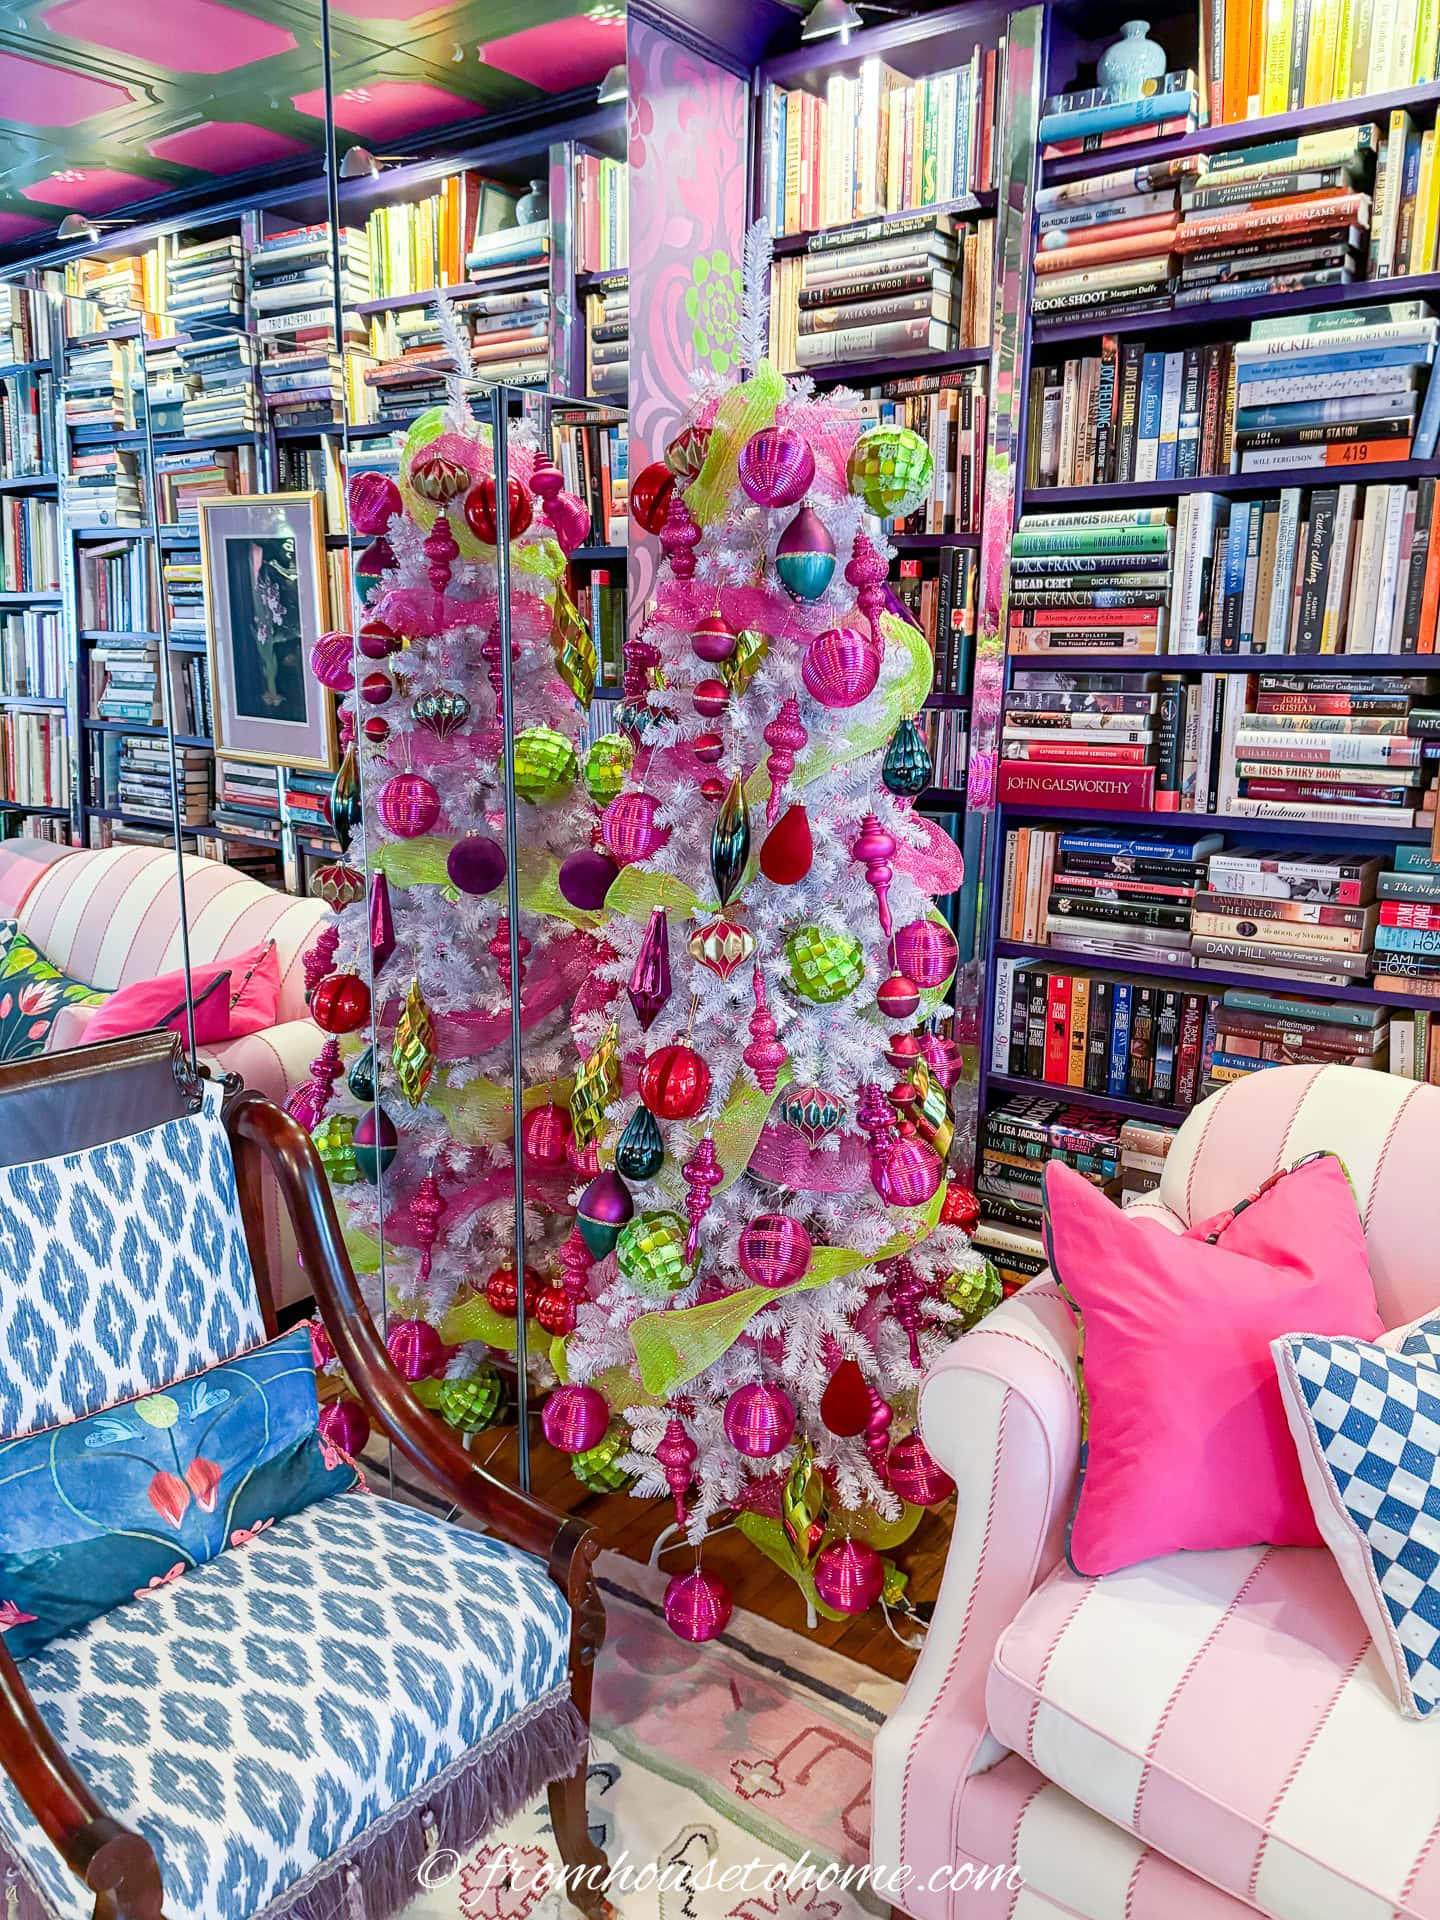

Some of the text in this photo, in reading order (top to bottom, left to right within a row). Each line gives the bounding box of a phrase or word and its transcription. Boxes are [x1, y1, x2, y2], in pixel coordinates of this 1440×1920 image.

[1181, 228, 1197, 239] KIM
[1199, 222, 1238, 235] EDWARDS
[1260, 215, 1283, 226] LAKE
[1295, 206, 1335, 221] DREAMS
[832, 279, 902, 296] MARGARET ATWOOD
[1110, 288, 1138, 298] Margaret
[1139, 284, 1157, 295] Duffy
[844, 303, 898, 321] ALIAS GRACE
[1267, 338, 1314, 354] RICKIE
[897, 373, 962, 393] SANDRA BROWN OUTFOX
[1185, 367, 1198, 411] JOY FIELDING
[1096, 365, 1113, 440] JOY FIELDING THE
[1122, 366, 1137, 426] JOY FIELDING
[1145, 395, 1158, 434] FIELDING
[1078, 422, 1086, 441] SO
[1299, 426, 1359, 441] UNION STATION
[1252, 444, 1369, 465] WILL FERGUSON 419
[1050, 512, 1137, 527] FRANCIS BREAK
[1305, 513, 1328, 584] cuckoo's calling
[1016, 557, 1147, 573] DICK FRANCIS SHATTERED
[1015, 577, 1141, 590] DEAD CERT DICK FRANCIS
[1227, 536, 1240, 628] MOUNTAIN FRAZIER
[1014, 591, 1093, 606] DICK FRANCIS
[1104, 597, 1135, 605] WIND
[1303, 591, 1312, 626] GALBRAITH
[1311, 596, 1319, 620] ROBERT
[938, 608, 947, 637] garden
[1308, 682, 1334, 691] Heather
[1272, 700, 1377, 712] GRISHAM SOOLEY
[1282, 696, 1308, 704] JOHN
[1281, 719, 1298, 729] The
[1259, 766, 1342, 779] IRISH FAIRY BOOK
[1007, 776, 1132, 795] JOHN GALSWORTHY
[1255, 803, 1308, 819] Sandman
[1216, 860, 1244, 868] Lawrence
[1058, 874, 1094, 886] Captivity
[1094, 878, 1114, 887] Tales
[1393, 882, 1413, 893] The
[1076, 905, 1139, 917] ELIZABETH HAY
[1220, 905, 1284, 919] THE ILLEGAL
[1396, 903, 1414, 928] TAMI
[1413, 904, 1431, 929] HOAG
[1206, 942, 1234, 955] DAN
[1237, 945, 1266, 960] HILL
[1293, 952, 1319, 961] Father's
[1319, 954, 1332, 962] Son
[1385, 952, 1414, 965] TAMI
[1379, 963, 1417, 976] HOAG
[996, 973, 1007, 1025] TAMI HOAG
[1033, 997, 1044, 1006] CRY
[1030, 1005, 1046, 1014] WOLF
[1052, 1003, 1066, 1011] TAMI
[1052, 1011, 1066, 1019] HOAG
[1115, 1020, 1128, 1028] HOAG
[1277, 1020, 1315, 1032] afterimage
[1029, 1029, 1044, 1038] TAMI
[1029, 1037, 1043, 1047] HOAG
[1113, 1056, 1126, 1064] DUST
[1179, 1021, 1192, 1094] HOAG ACTS
[1184, 1024, 1198, 1103] TAMI PRIOR BAD
[1233, 1059, 1246, 1067] THE
[1111, 1072, 1125, 1080] DUST
[1156, 1074, 1171, 1082] TAMI
[1154, 1081, 1171, 1089] HOAG
[1001, 1094, 1037, 1114] LISA
[999, 1124, 1048, 1143] LISA JACKSON
[988, 1138, 1006, 1149] LISA
[1063, 1136, 1096, 1148] OUR LITTLE
[1008, 1169, 1041, 1183] Deafenin
[994, 1256, 1038, 1273] MONK KIDD
